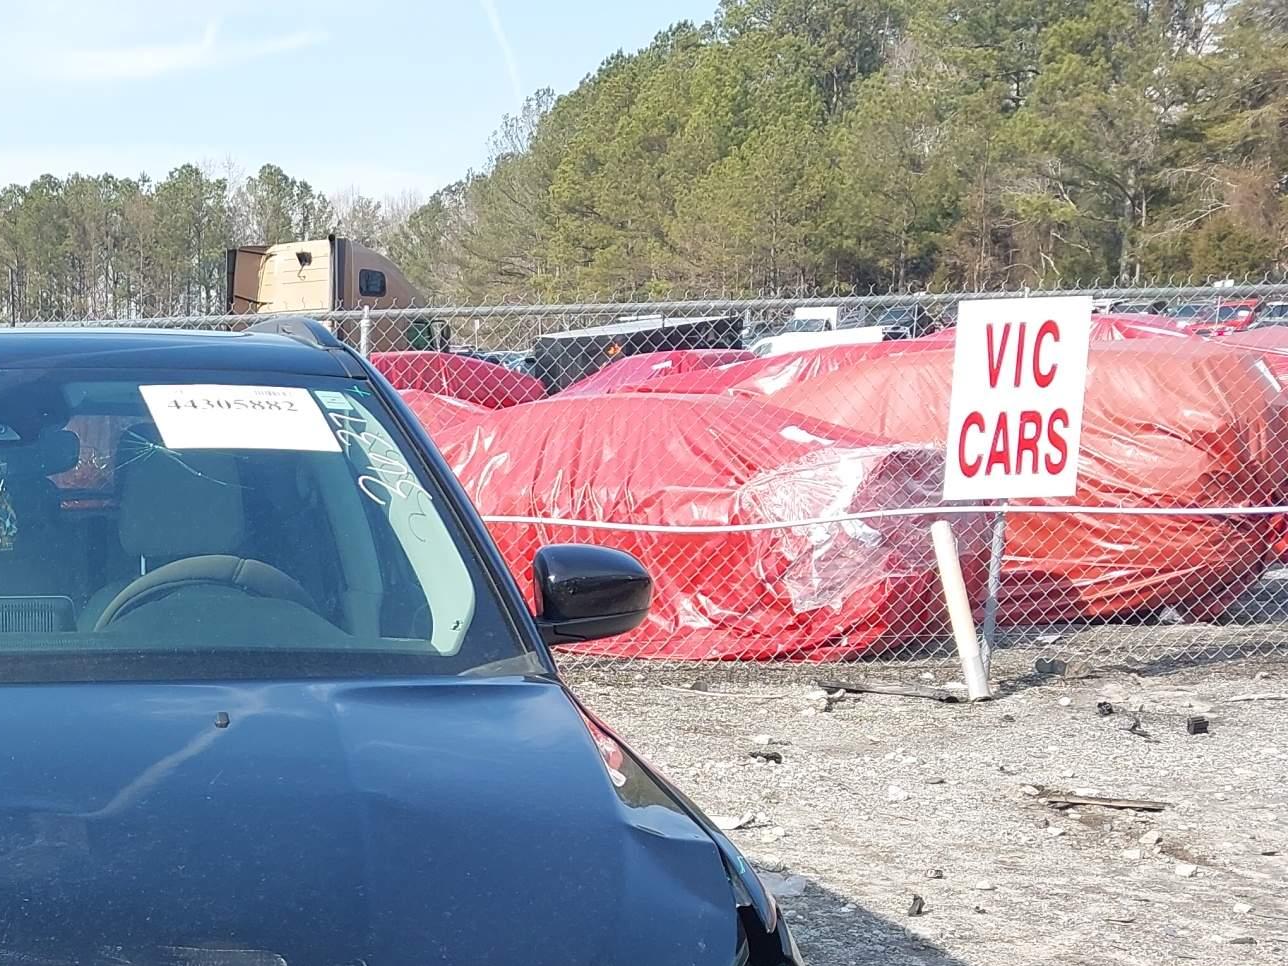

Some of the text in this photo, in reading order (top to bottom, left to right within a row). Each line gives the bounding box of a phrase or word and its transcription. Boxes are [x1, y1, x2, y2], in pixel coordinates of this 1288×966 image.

[986, 319, 1060, 388] VIC
[167, 398, 299, 413] 44305882
[958, 408, 1070, 478] CARS
